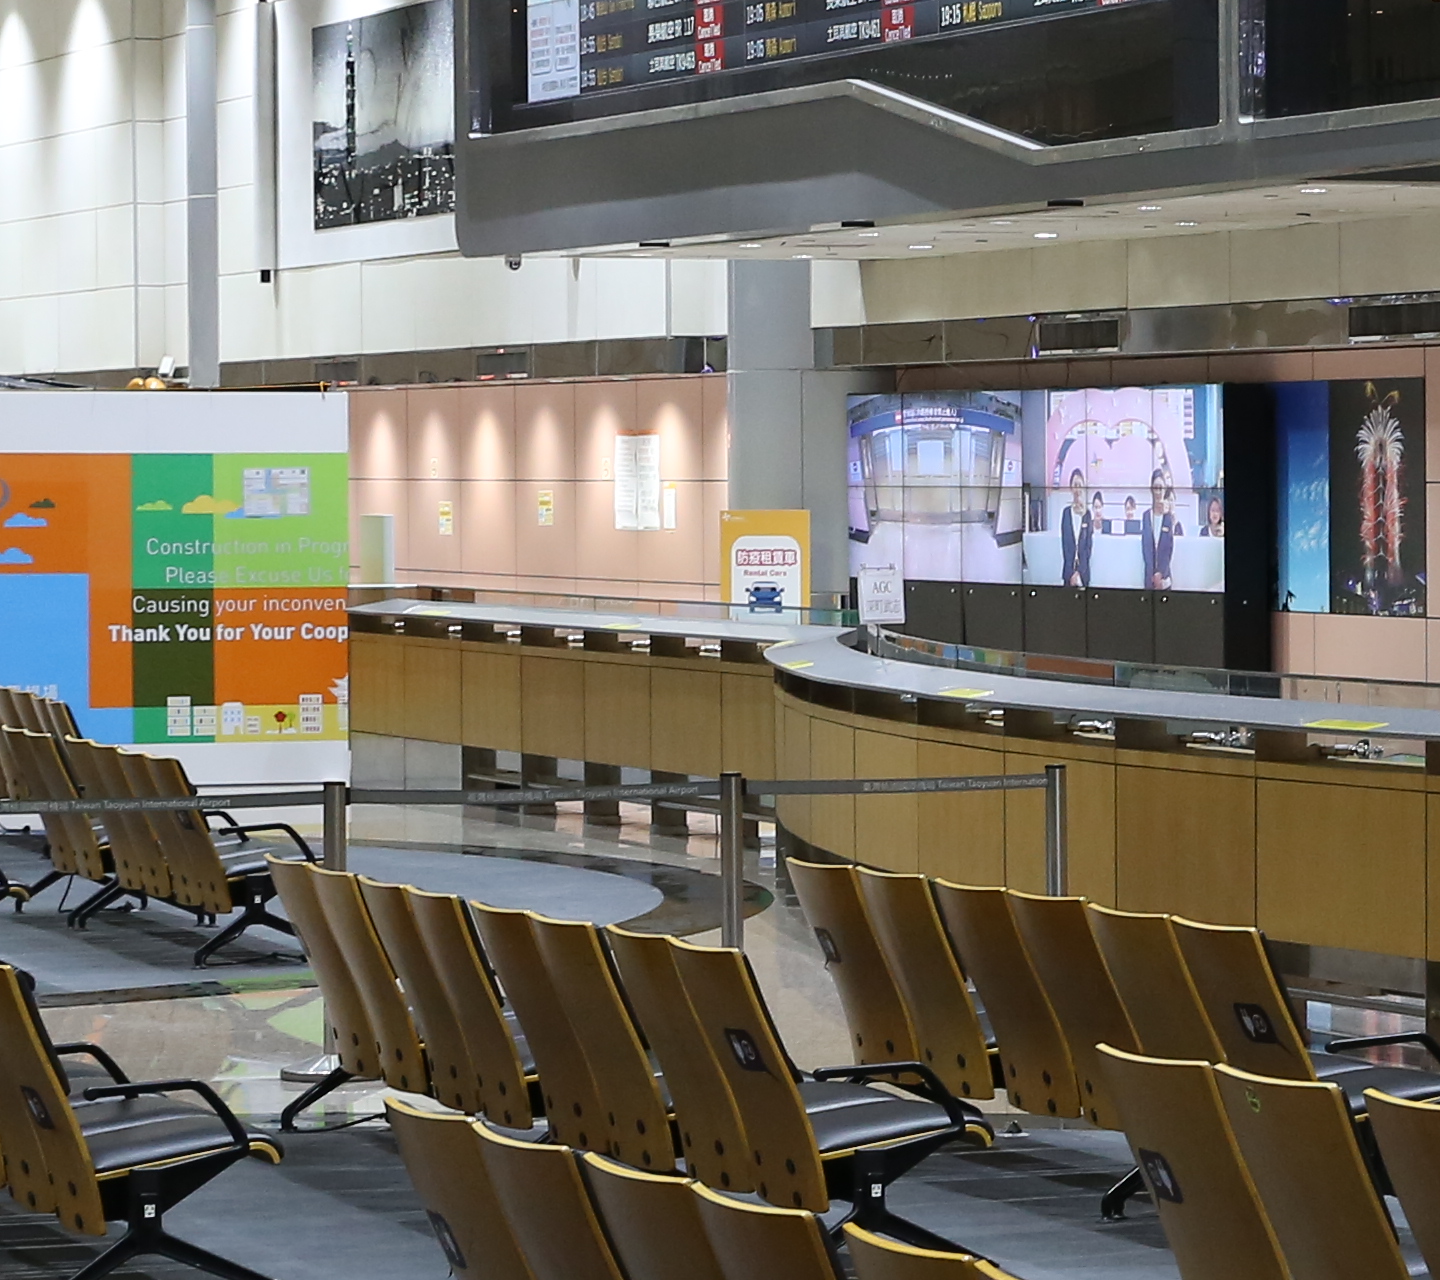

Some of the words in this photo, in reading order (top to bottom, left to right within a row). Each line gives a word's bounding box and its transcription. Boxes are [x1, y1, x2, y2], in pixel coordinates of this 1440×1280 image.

[146, 537, 268, 555] Construction
[736, 549, 797, 566] 防疫租賃車
[166, 566, 229, 584] Please
[236, 566, 300, 583] Excuse
[308, 566, 333, 582] Us
[872, 581, 892, 593] AGC
[133, 595, 210, 618] Causing
[216, 598, 257, 617] your
[263, 594, 347, 613] inconven
[108, 624, 170, 642] Thank
[175, 624, 211, 642] You
[216, 623, 245, 640] for
[250, 623, 295, 640] Your
[301, 622, 349, 643] Coop
